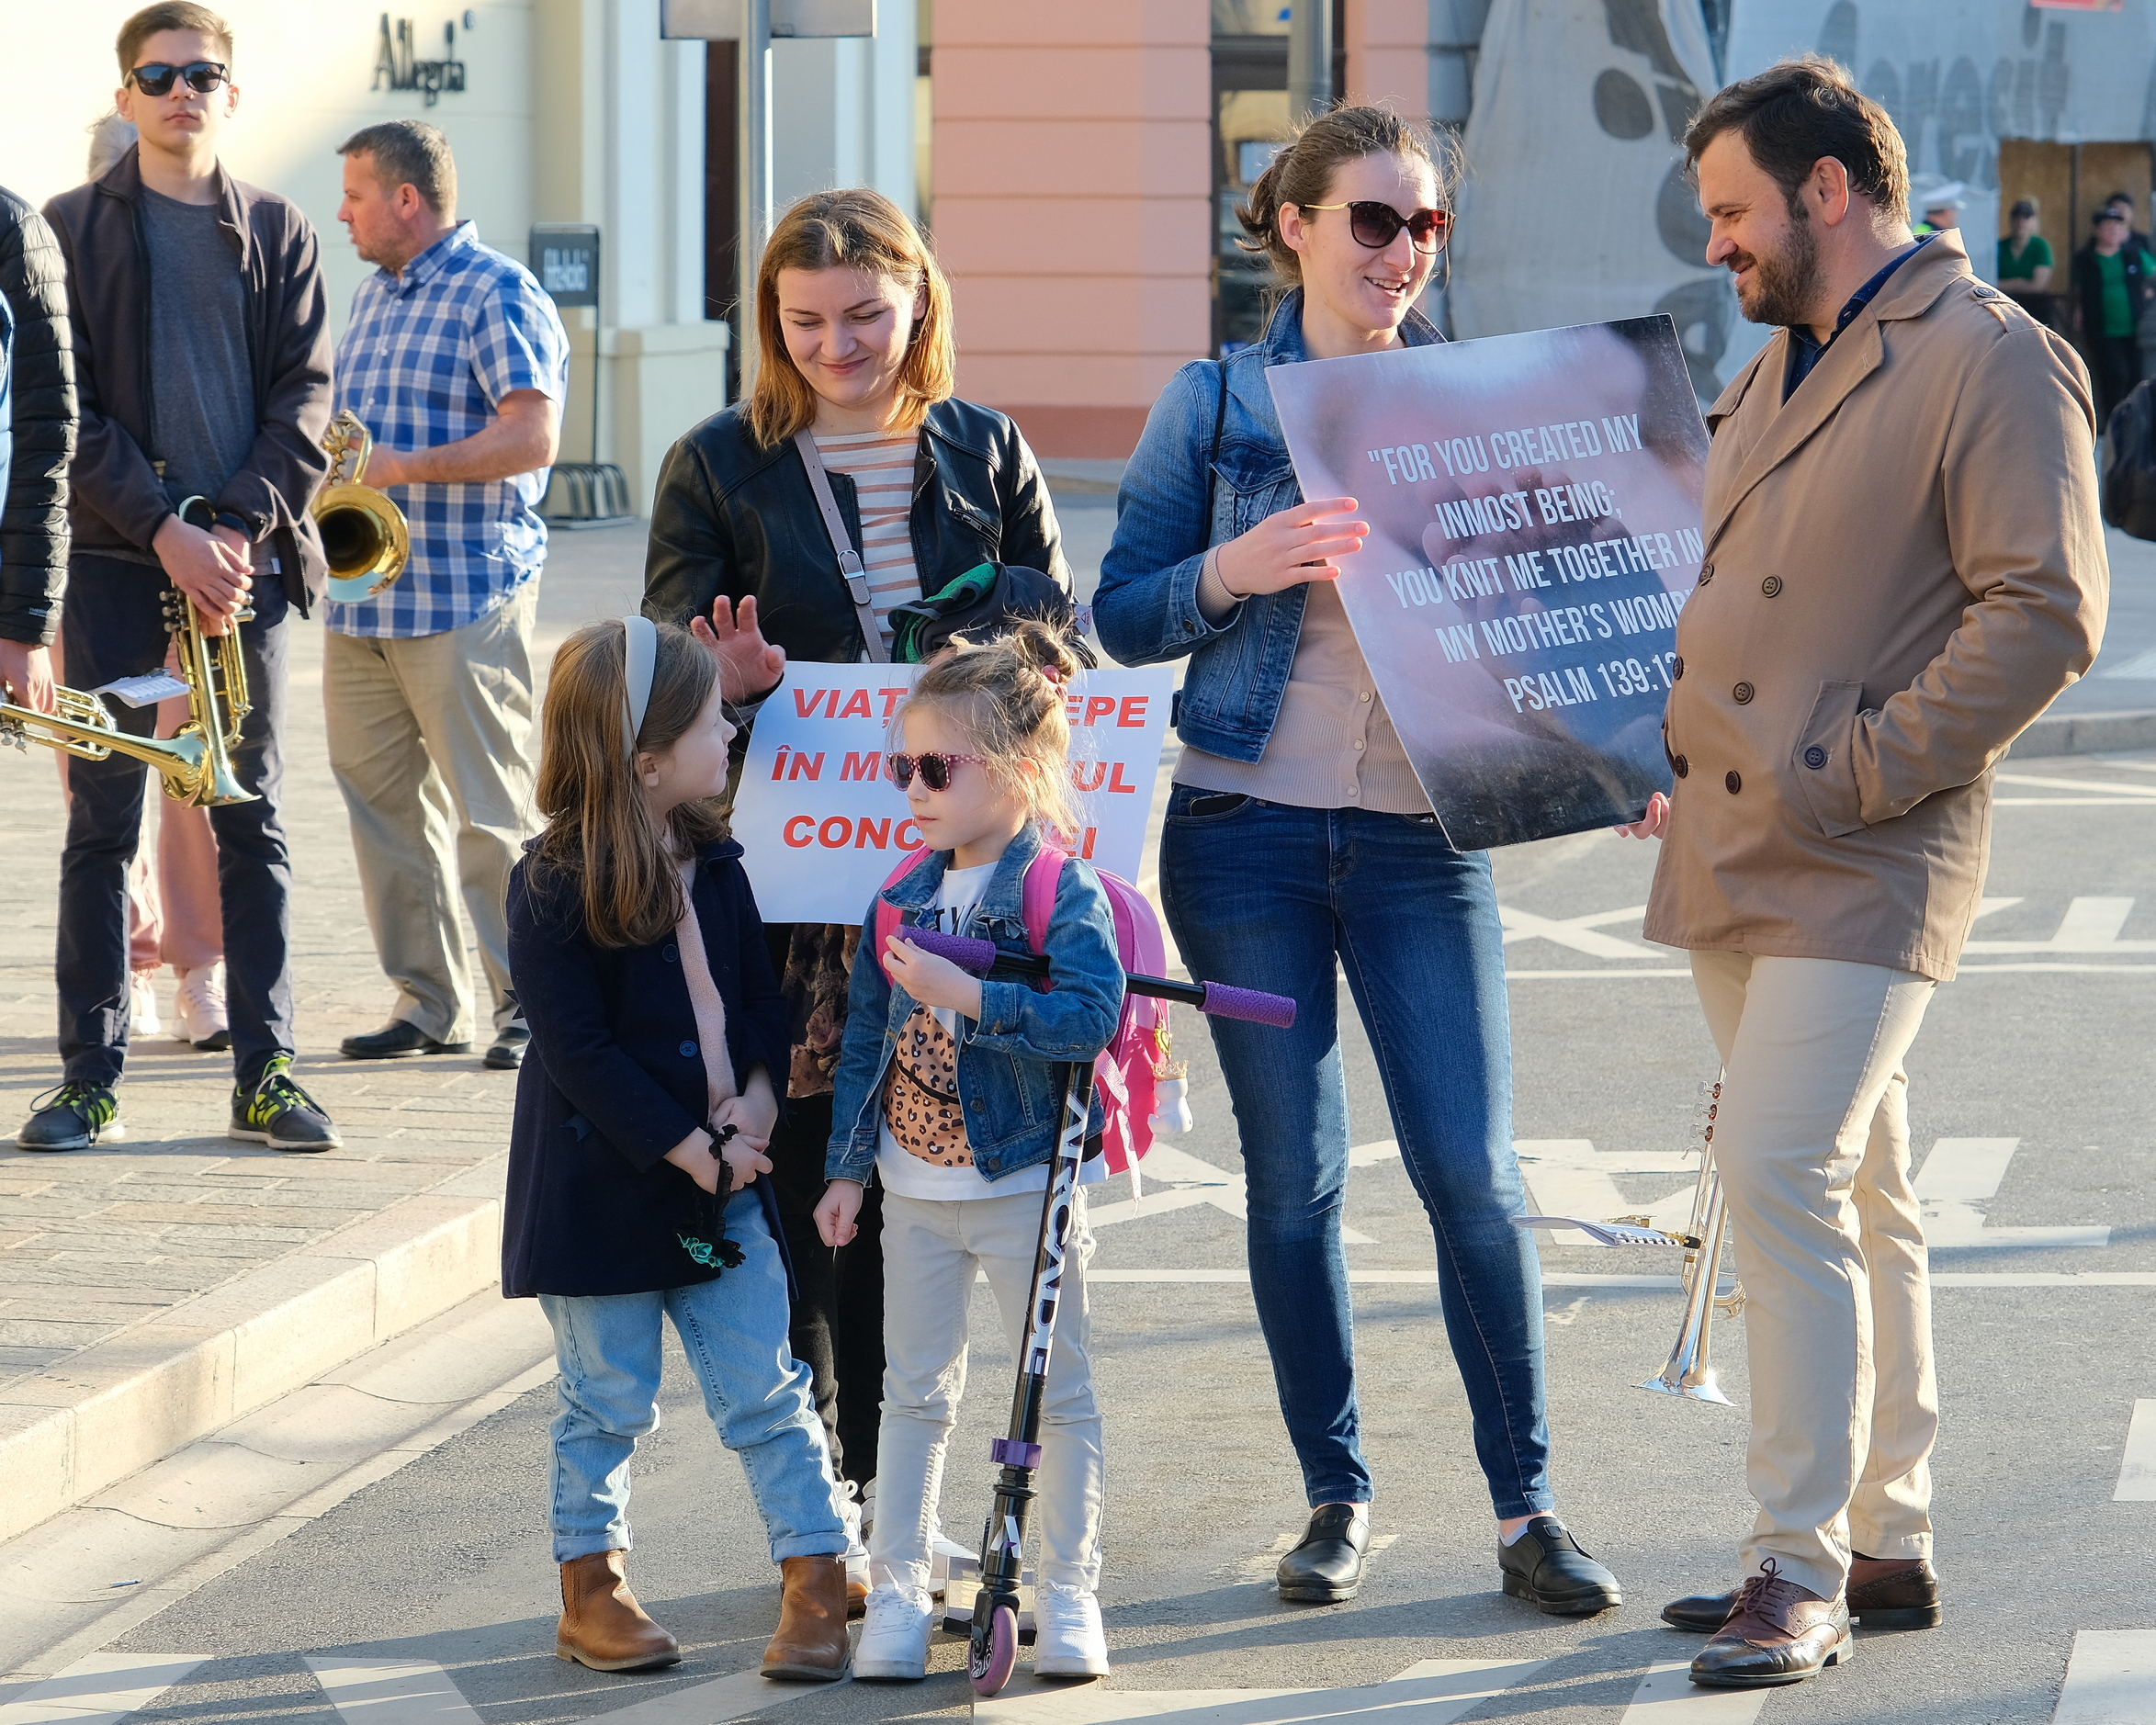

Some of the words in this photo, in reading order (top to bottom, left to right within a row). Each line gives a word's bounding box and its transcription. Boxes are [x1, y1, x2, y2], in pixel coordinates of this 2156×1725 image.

[1367, 443, 1437, 485] "FOR
[1433, 434, 1491, 477] YOU
[1490, 420, 1603, 470] CREATED
[1601, 413, 1642, 454] MY
[1434, 490, 1534, 540] INMOST
[1534, 479, 1623, 524] BEING;
[1385, 566, 1444, 610] YOU
[1440, 558, 1506, 602] KNIT
[1505, 550, 1552, 592] ME
[1546, 532, 1678, 585] TOGETHER
[1675, 526, 1705, 564] IN
[1435, 623, 1481, 664] MY
[1480, 602, 1612, 658] MOTHER'S
[1504, 666, 1597, 714] PSALM
[1597, 651, 1676, 698] 139:1
[771, 744, 825, 781] ÎN
